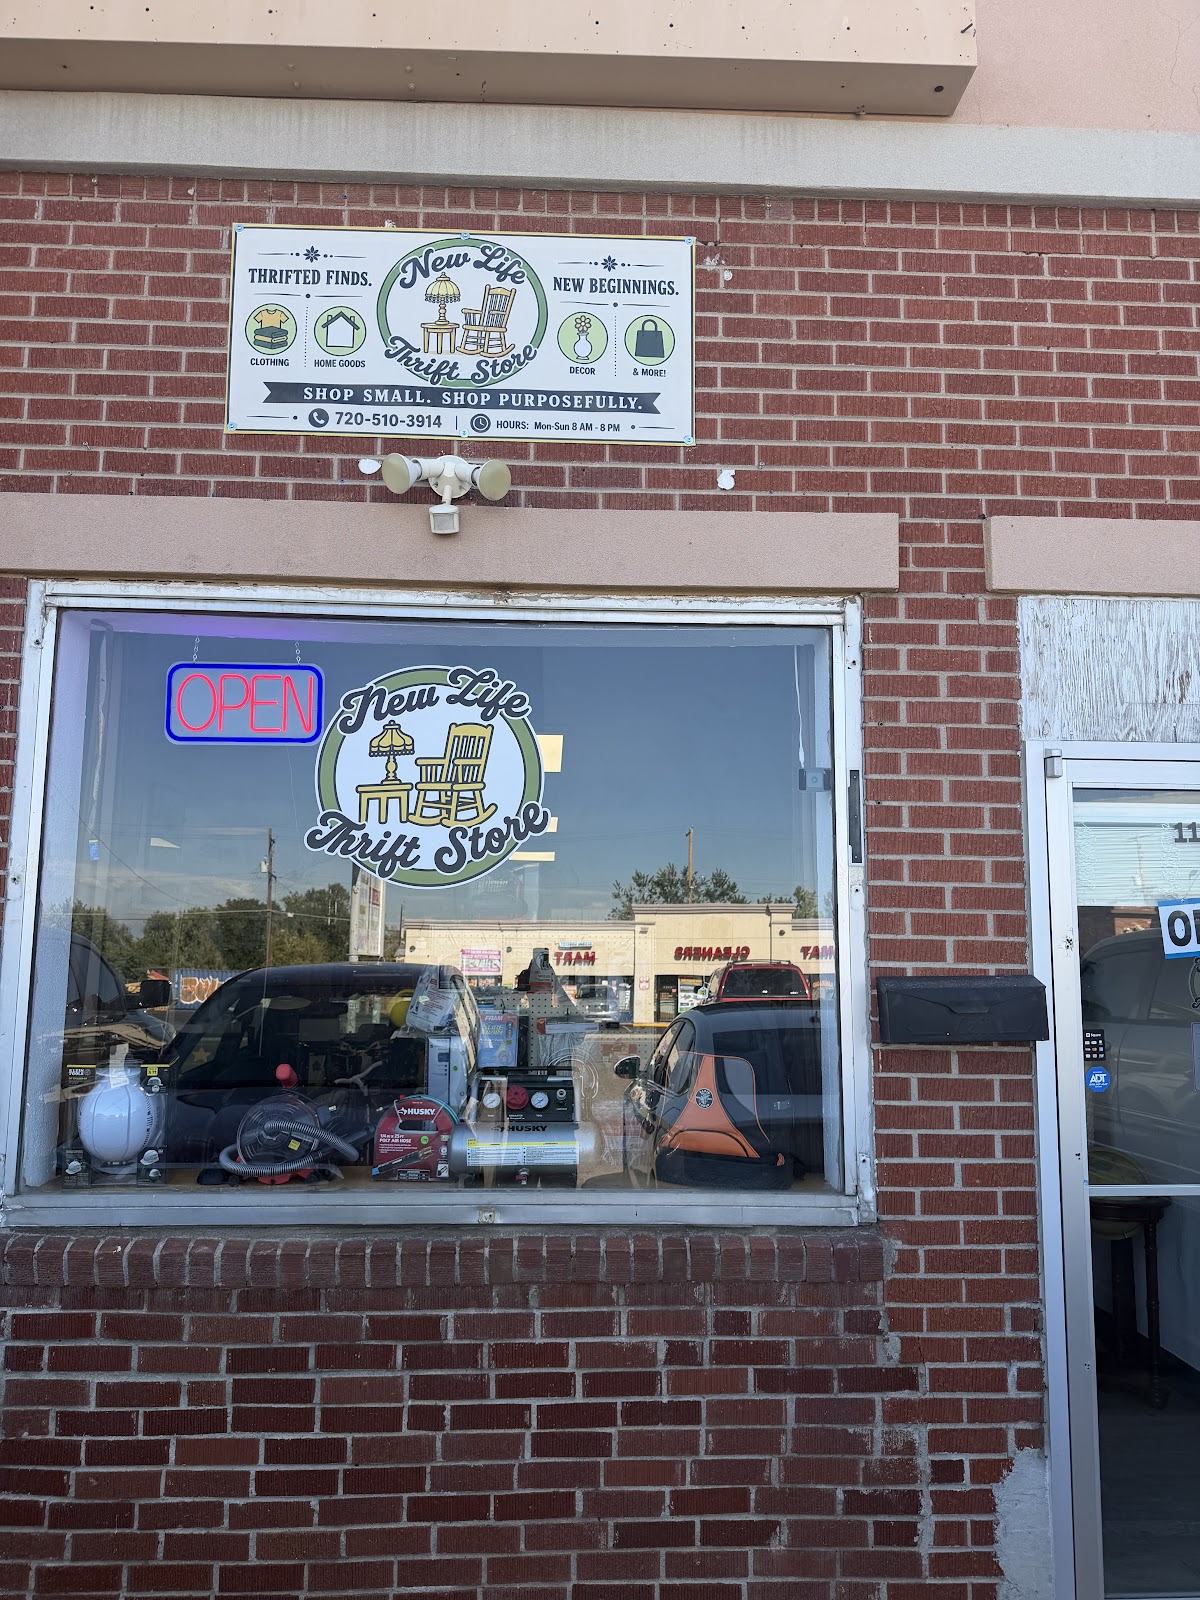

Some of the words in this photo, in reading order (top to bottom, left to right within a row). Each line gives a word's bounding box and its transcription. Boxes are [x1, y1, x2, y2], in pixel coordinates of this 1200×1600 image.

[399, 248, 471, 289] New
[472, 245, 526, 285] Life
[248, 268, 321, 285] THRIFTED
[325, 270, 373, 287] FINDS.
[553, 276, 585, 293] NEW
[589, 277, 680, 296] BEGINNINGS.
[250, 357, 290, 367] CLOTHING
[314, 358, 337, 368] HOME
[338, 359, 366, 369] GOODS
[384, 335, 460, 385] Thrift
[470, 344, 538, 385] Store
[569, 366, 596, 376] DECOR
[632, 367, 640, 376] &
[641, 368, 667, 377] MORE!
[303, 386, 354, 401] SHOP
[363, 388, 431, 404] SMALL.
[442, 391, 491, 406] SHOP
[499, 392, 643, 410] PURPOSEFULLY.
[335, 411, 442, 429] 720-510-3914
[496, 420, 529, 430] HOURS:
[534, 421, 570, 431] Mon-Sun
[571, 423, 578, 431] 8
[579, 422, 593, 431] AM
[600, 423, 606, 432] 8
[607, 423, 620, 432] PM
[175, 673, 314, 734] OPEN
[337, 685, 439, 734] New
[445, 668, 530, 722] Life
[306, 813, 422, 879] Thrift
[434, 802, 549, 874] Store
[1090, 1073, 1107, 1083] ADT
